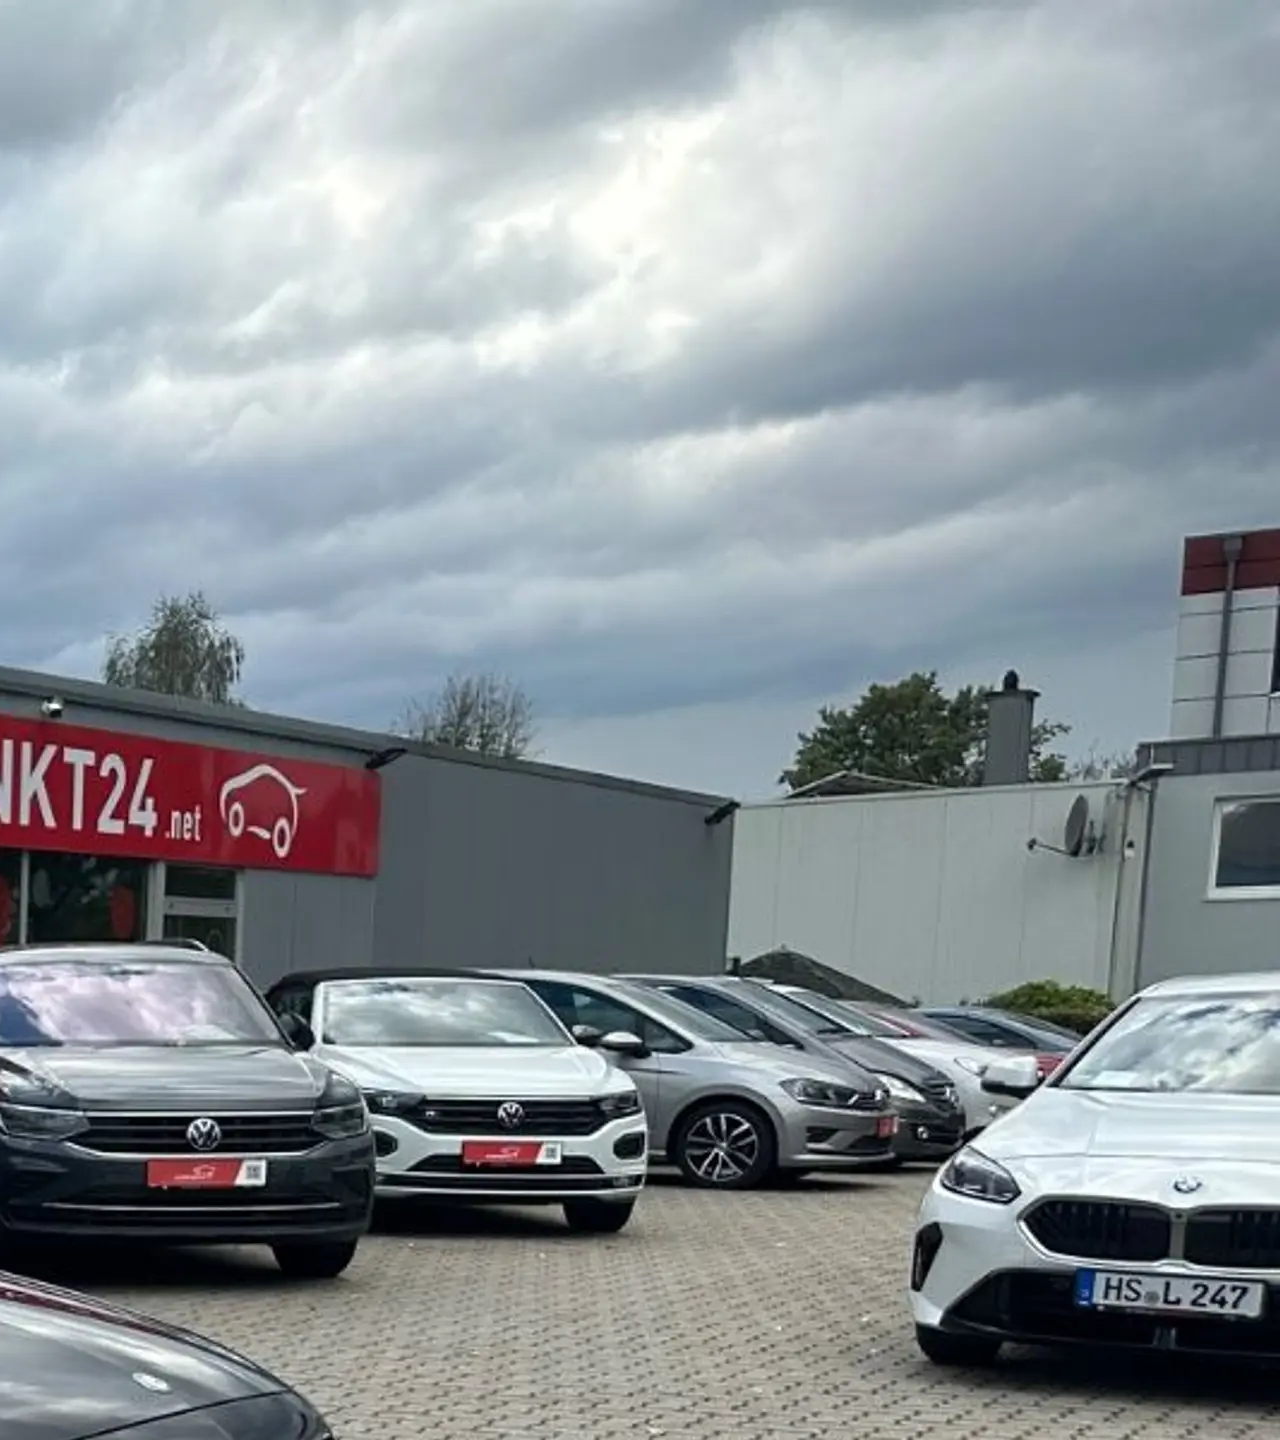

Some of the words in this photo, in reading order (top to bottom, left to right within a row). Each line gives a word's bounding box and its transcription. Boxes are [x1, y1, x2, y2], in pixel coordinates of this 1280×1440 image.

[165, 803, 203, 843] .net
[1102, 1276, 1142, 1302] HS
[1162, 1280, 1181, 1306] L
[1191, 1283, 1249, 1310] 247
